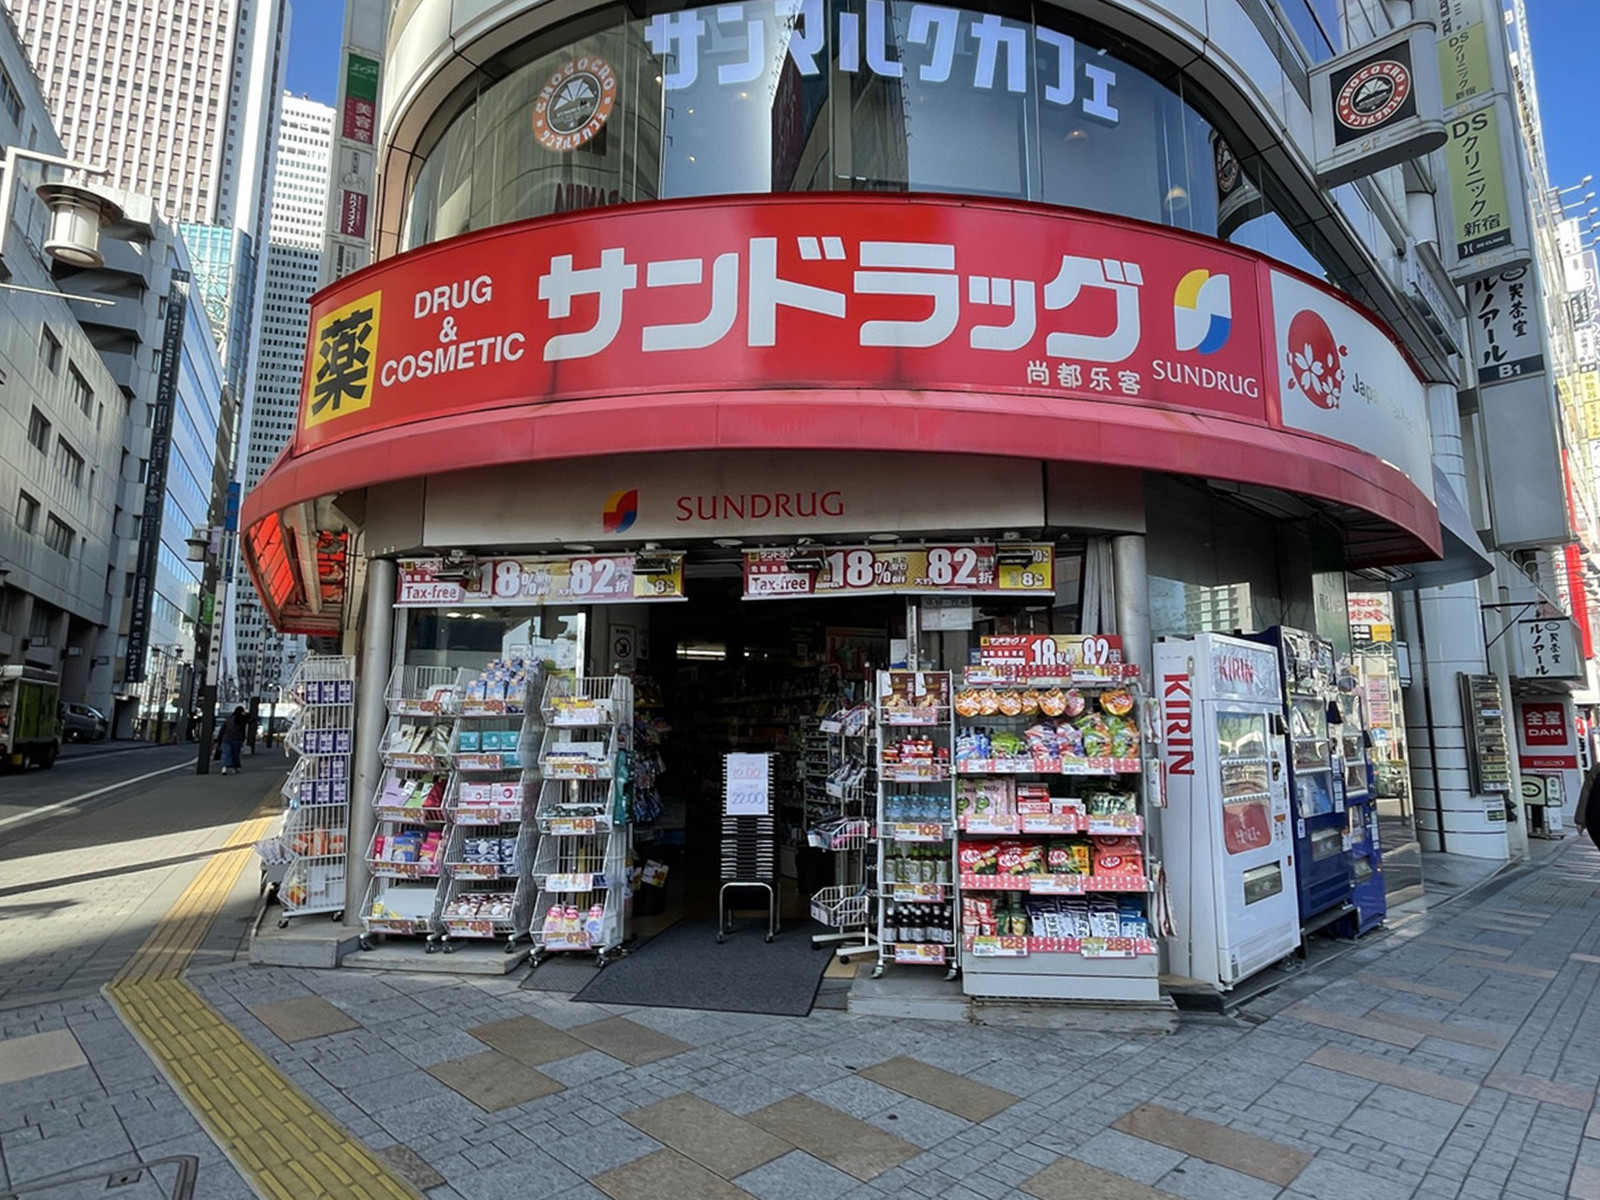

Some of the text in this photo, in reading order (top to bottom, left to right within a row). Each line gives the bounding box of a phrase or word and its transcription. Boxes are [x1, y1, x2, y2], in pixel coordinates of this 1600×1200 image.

[644, 0, 1119, 123] サンマルクカフェ
[354, 102, 372, 140] 美容室
[1452, 113, 1488, 139] DS
[1462, 136, 1488, 218] クリニック
[1464, 213, 1501, 237] 新宿
[414, 275, 493, 319] DRUG
[538, 236, 1143, 362] サンドラッグ
[439, 316, 458, 343] &
[1475, 277, 1508, 364] ルノアール
[311, 307, 374, 416] 薬
[380, 332, 526, 387] COSMETIC
[1499, 364, 1522, 376] B1
[1027, 360, 1141, 395] 尚都乐客
[1152, 360, 1258, 398] SUNDRUG
[676, 491, 845, 521] SUNDRUG
[405, 585, 457, 599] Tax-free
[752, 577, 807, 591] Tax-free
[1530, 623, 1550, 676] ルノアール
[1219, 655, 1255, 684] KIRIN
[1164, 674, 1195, 776] KIRIN
[1526, 711, 1562, 725] 全室
[1528, 728, 1563, 736] DAM
[918, 824, 941, 836] 102
[1106, 938, 1132, 950] 288
